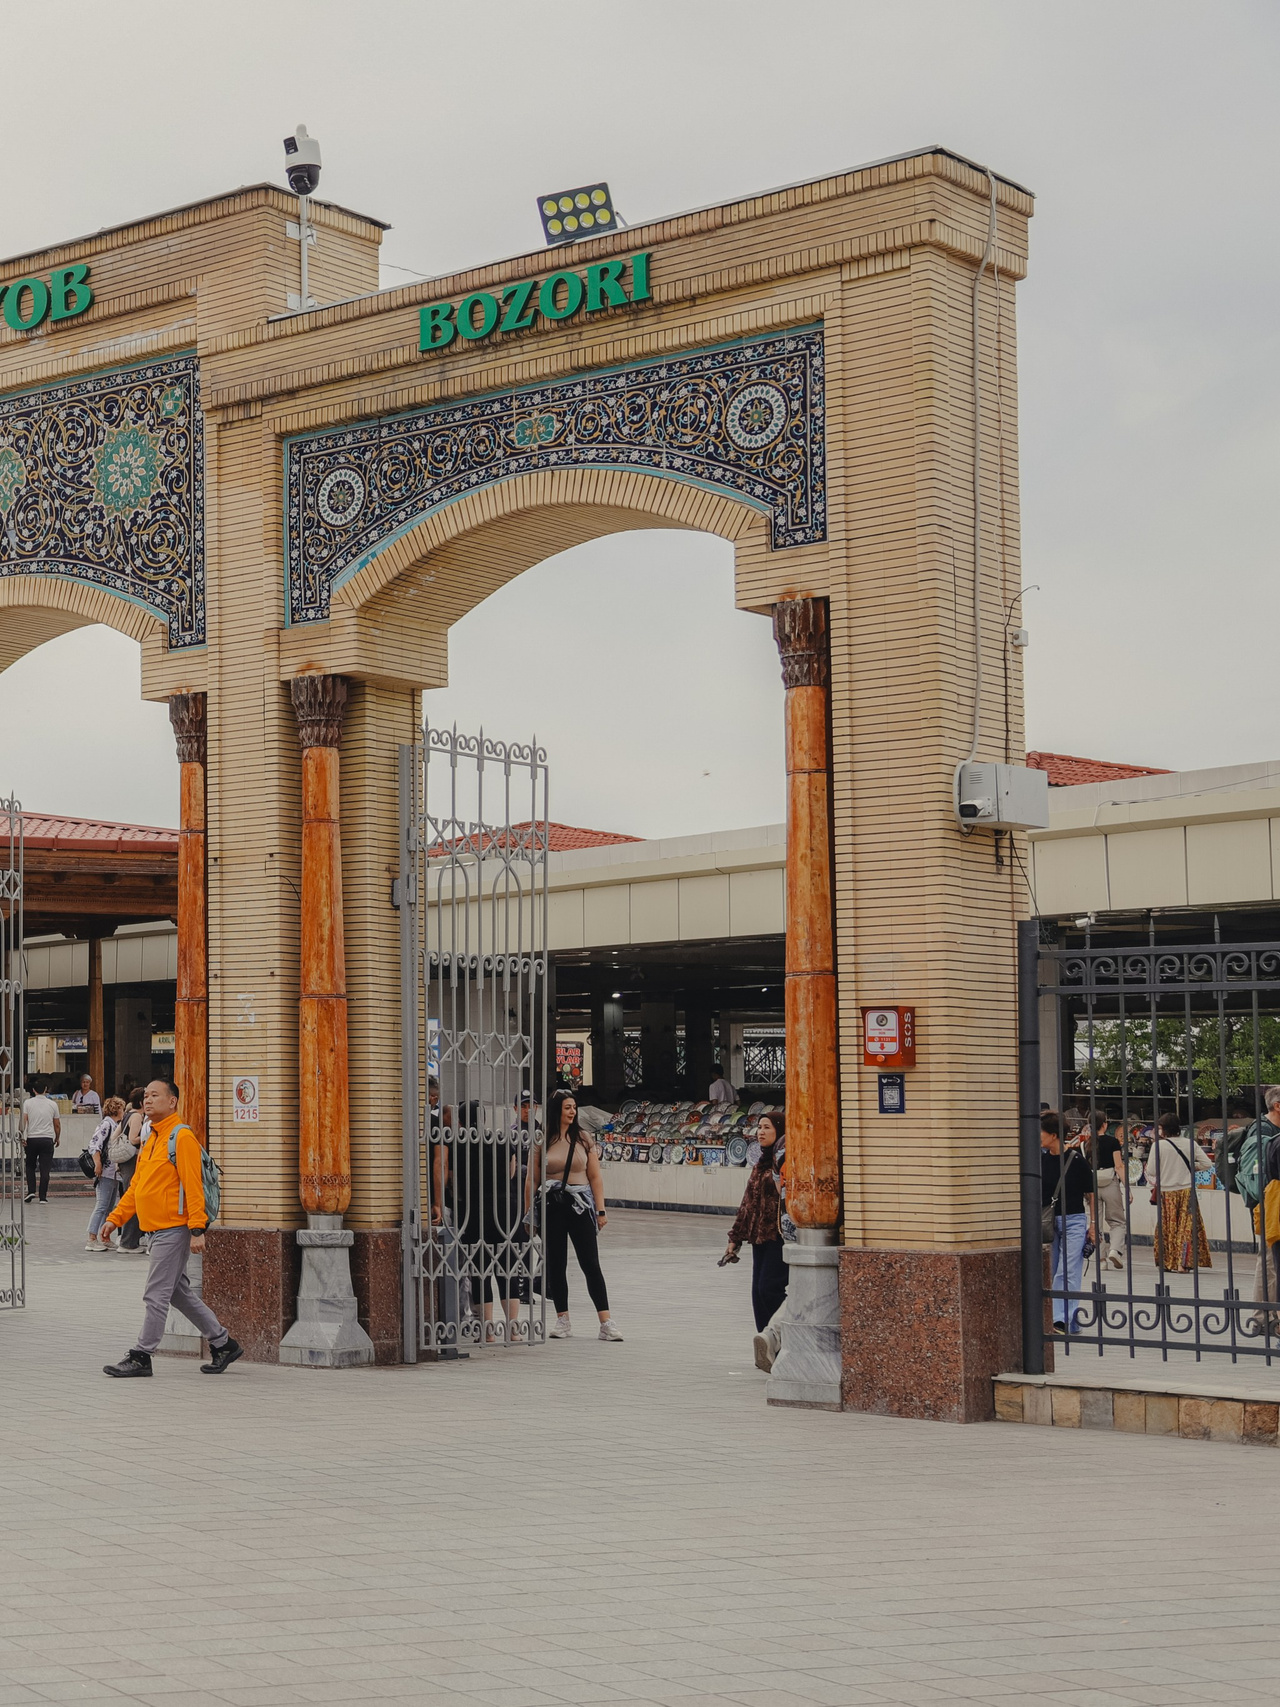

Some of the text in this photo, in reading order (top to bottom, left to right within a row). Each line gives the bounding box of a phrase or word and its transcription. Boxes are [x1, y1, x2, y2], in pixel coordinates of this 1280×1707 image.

[418, 252, 652, 351] BOZORI
[904, 1012, 912, 1047] SOS
[234, 1109, 258, 1119] 1215
